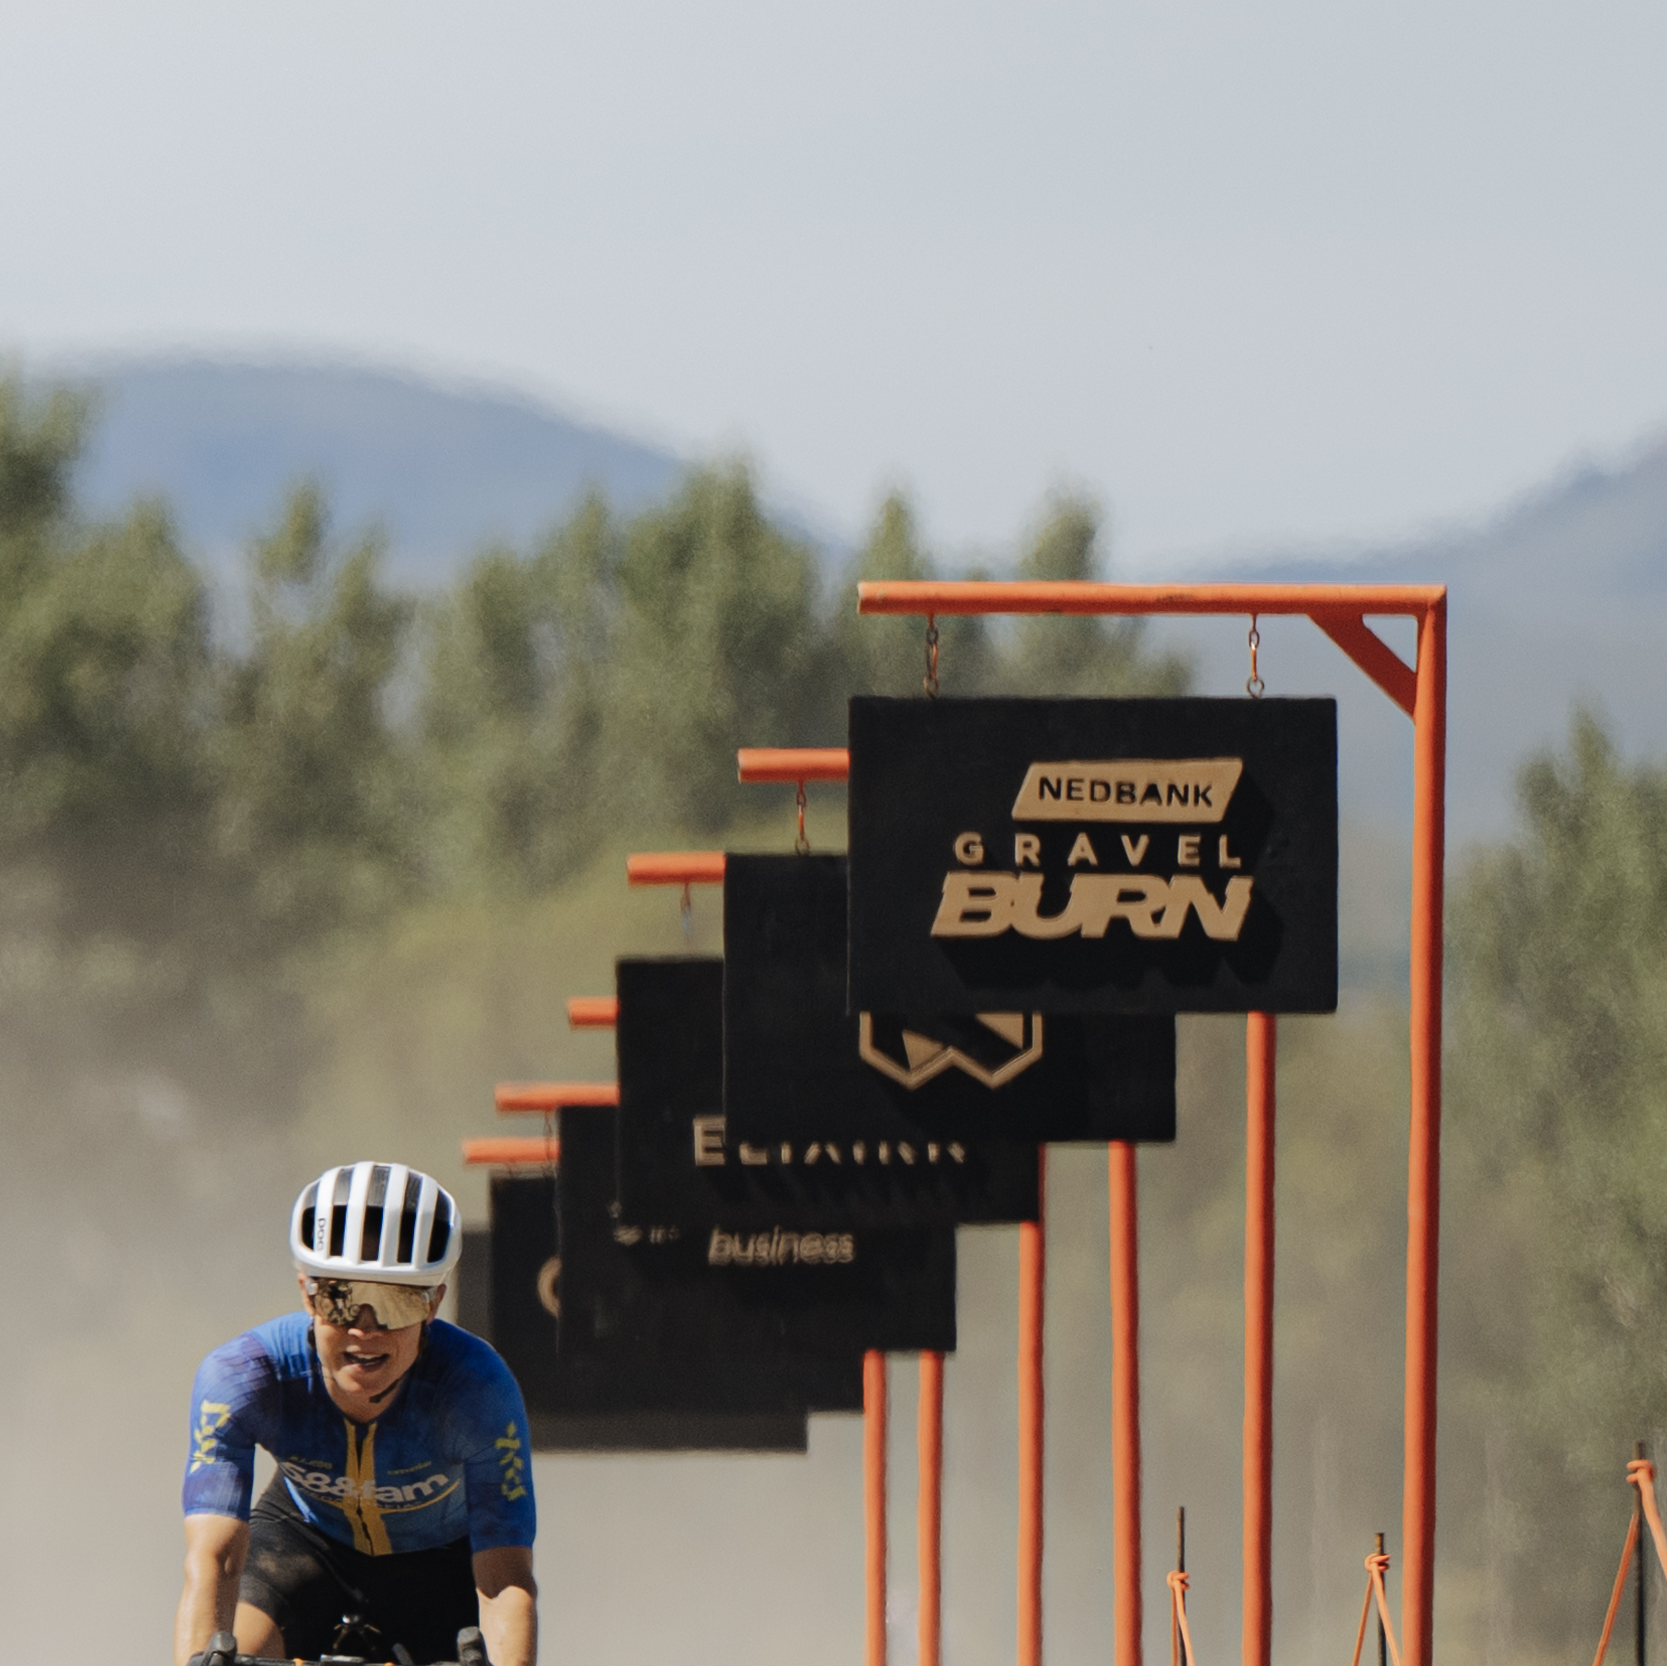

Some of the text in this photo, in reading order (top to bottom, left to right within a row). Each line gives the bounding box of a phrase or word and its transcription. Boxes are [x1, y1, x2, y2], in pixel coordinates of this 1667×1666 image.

[1039, 776, 1213, 807] NEDBANK
[954, 832, 1242, 868] GRAVEL
[931, 870, 1255, 941] BURN
